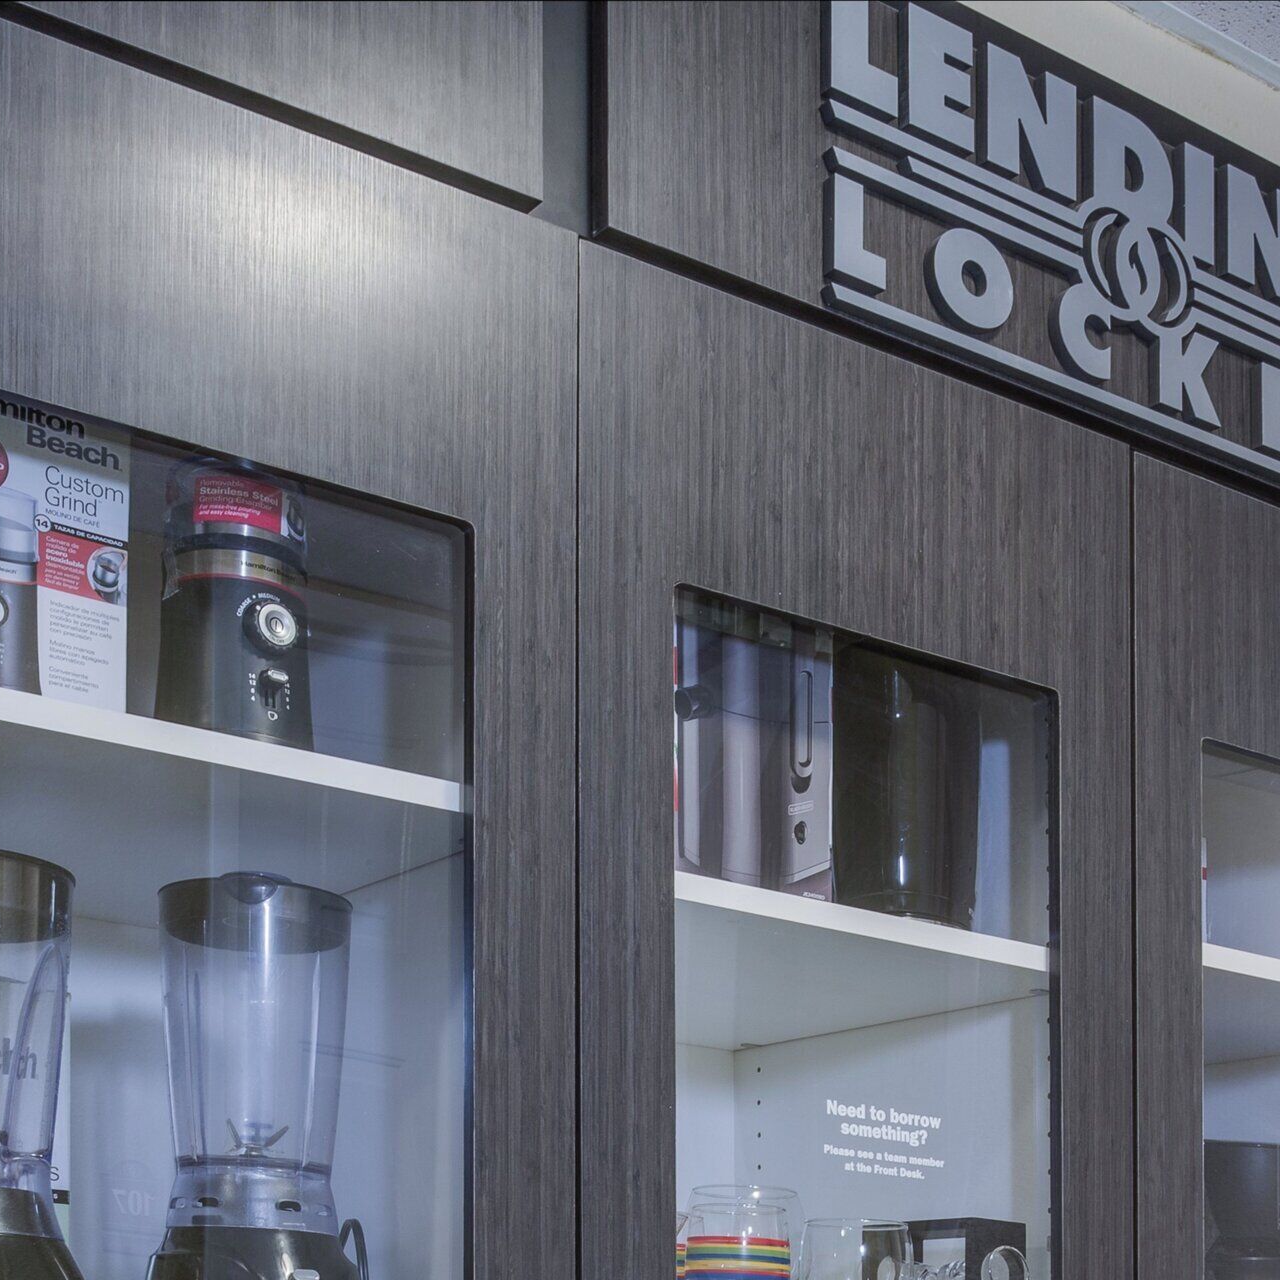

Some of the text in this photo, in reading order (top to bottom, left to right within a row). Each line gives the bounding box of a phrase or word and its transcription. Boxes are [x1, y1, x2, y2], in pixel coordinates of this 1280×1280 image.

[26, 425, 121, 471] Beach
[45, 466, 124, 504] Custom
[199, 486, 279, 506] Stainless Steel
[36, 519, 49, 529] 14
[53, 524, 75, 535] TAZAS
[826, 1099, 941, 1129] Need to borrow
[840, 1122, 928, 1147] something?
[823, 1144, 944, 1168] Please see a team member
[844, 1161, 925, 1180] at the Front Desk.
